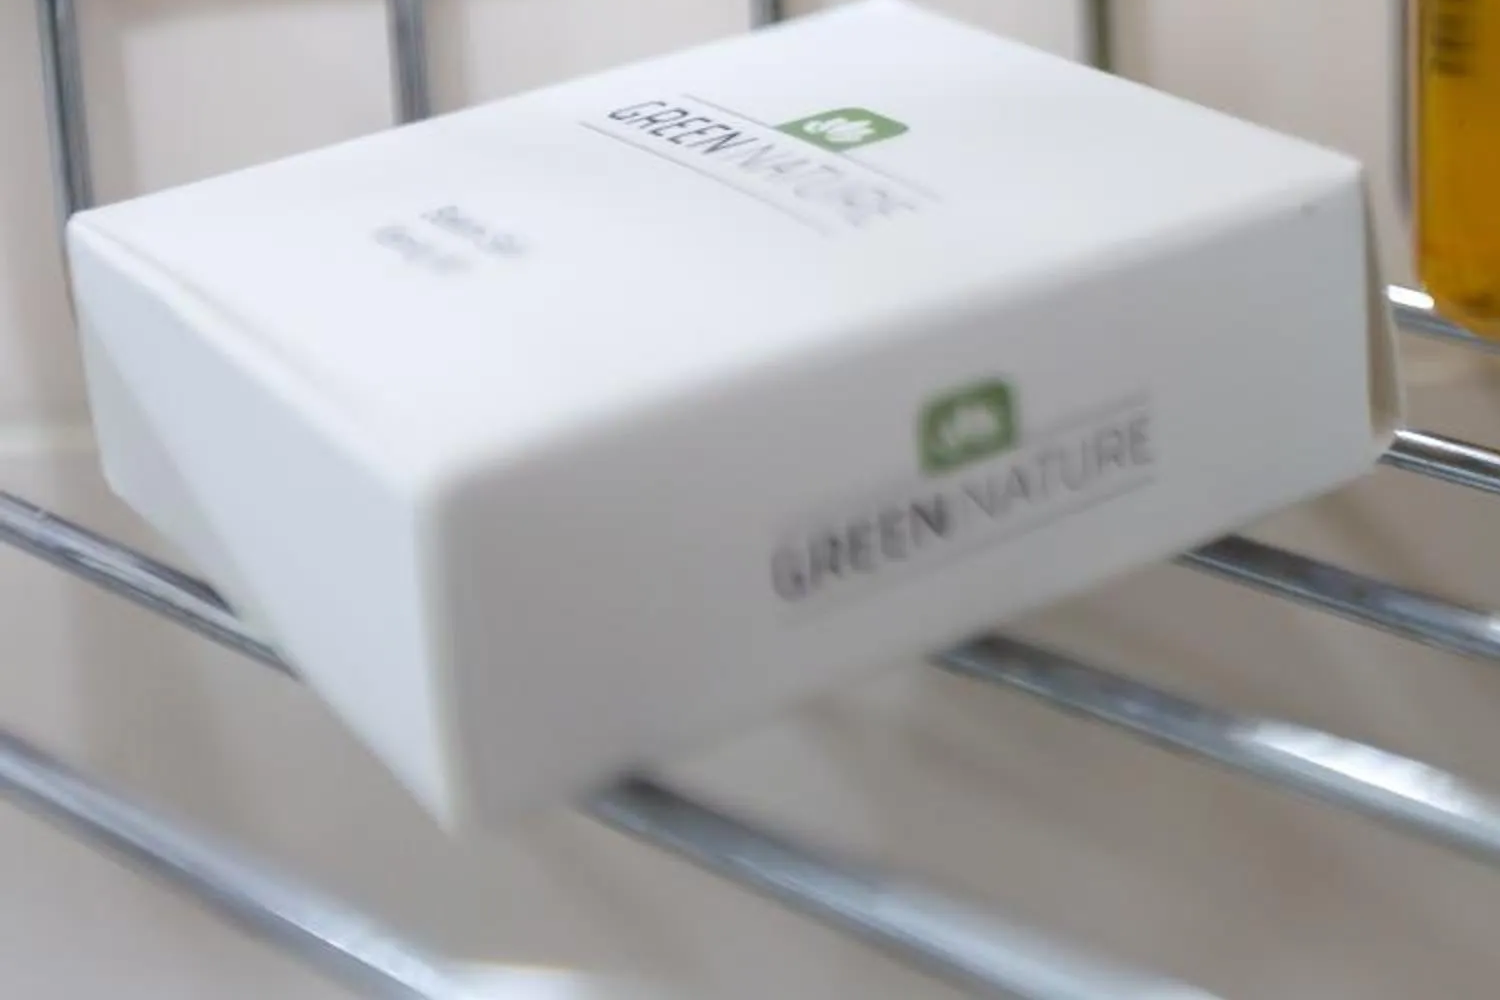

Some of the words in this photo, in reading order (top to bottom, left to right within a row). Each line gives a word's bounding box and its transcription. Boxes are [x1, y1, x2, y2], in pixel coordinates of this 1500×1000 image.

[607, 100, 758, 155] GREEN
[771, 494, 951, 602] GREEN
[960, 415, 1154, 518] NATURE
